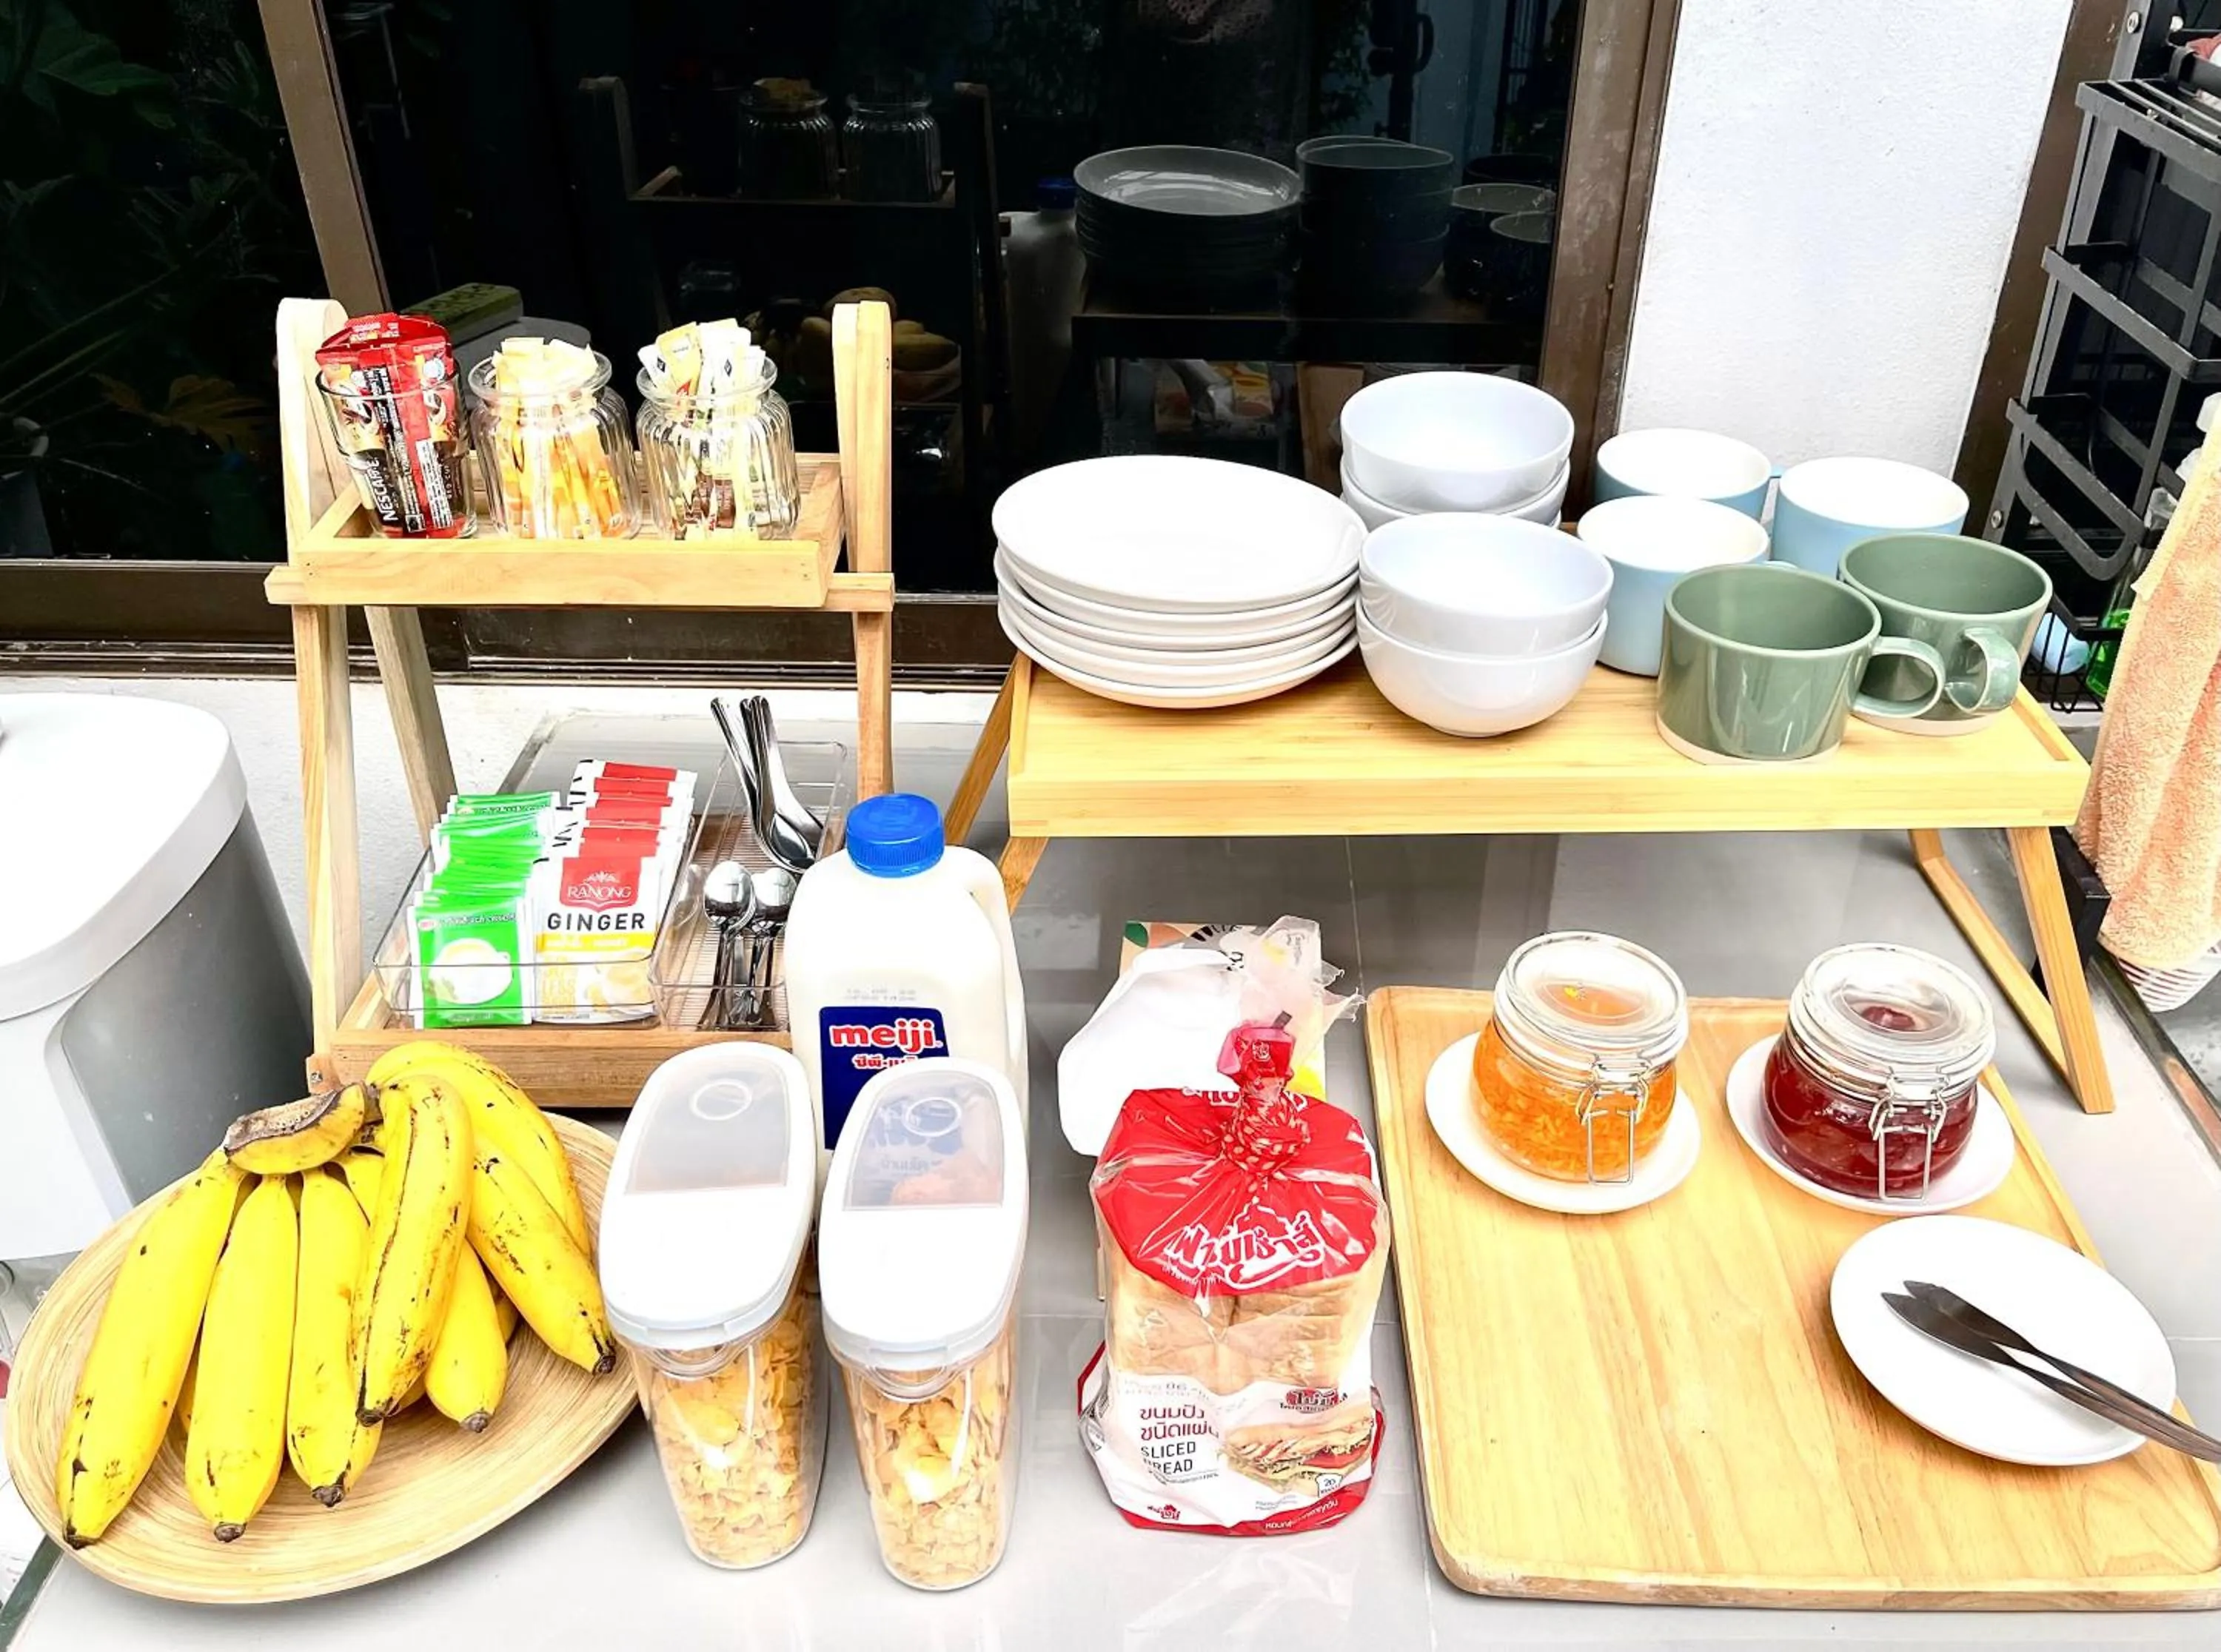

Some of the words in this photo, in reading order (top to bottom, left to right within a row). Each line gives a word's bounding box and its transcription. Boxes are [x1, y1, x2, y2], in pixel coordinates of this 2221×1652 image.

[567, 883, 632, 899] RANONG
[547, 913, 645, 931] GINGER
[830, 1018, 934, 1054] meiji
[1141, 1441, 1196, 1459] SLICED
